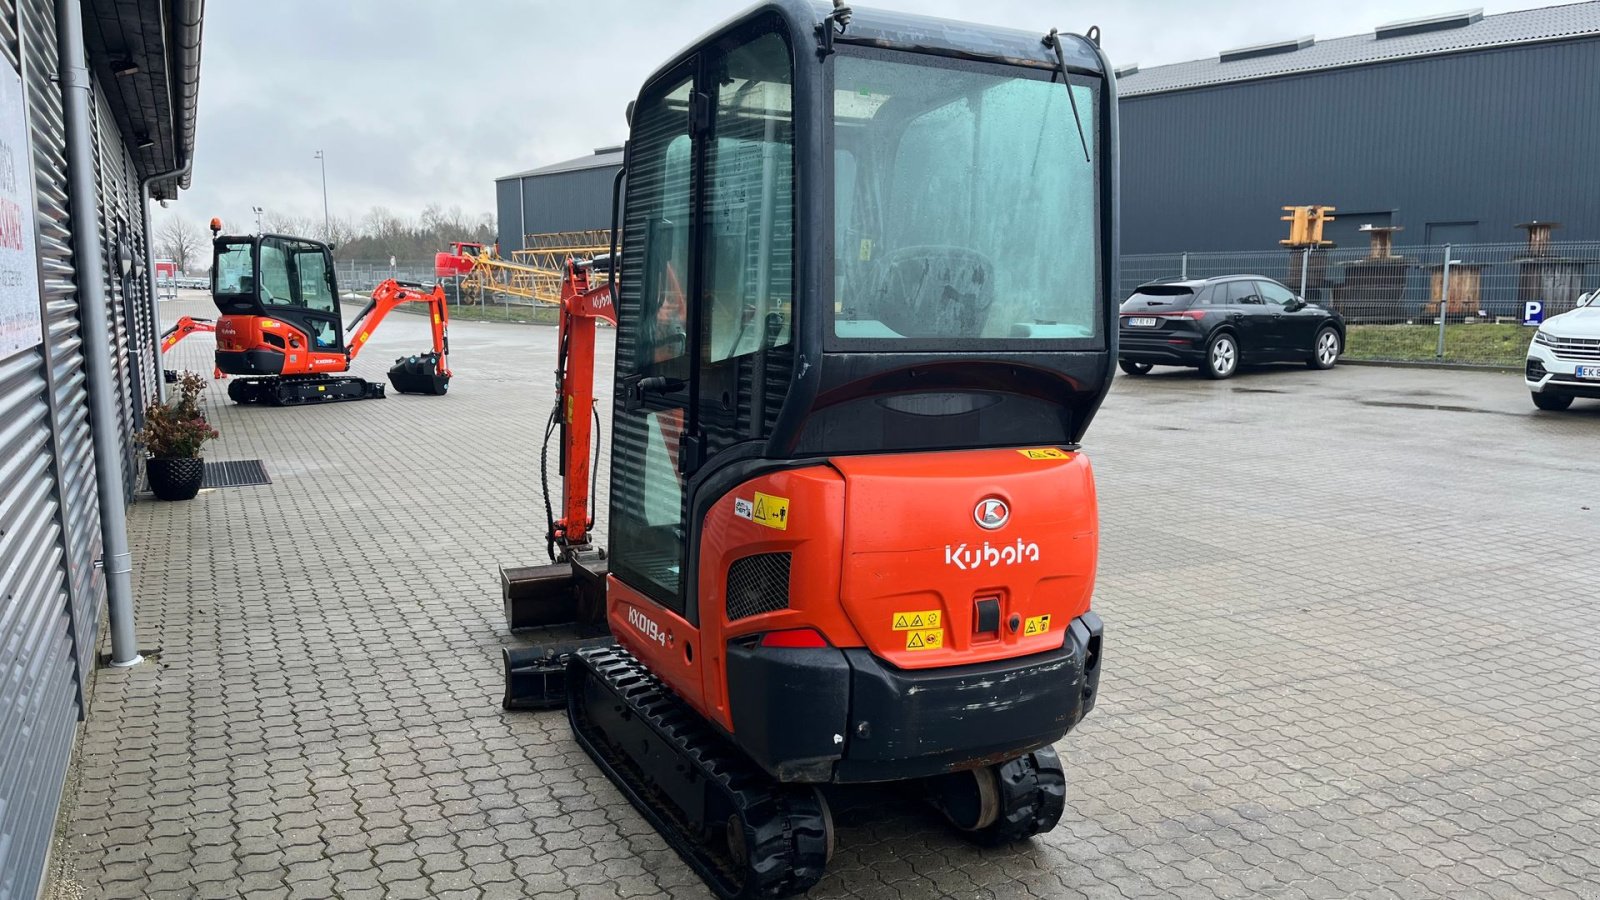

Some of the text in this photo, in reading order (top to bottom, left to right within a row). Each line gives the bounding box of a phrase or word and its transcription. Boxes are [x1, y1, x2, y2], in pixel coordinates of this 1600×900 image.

[1525, 301, 1541, 320] P
[1583, 368, 1594, 376] EK
[945, 538, 1039, 569] Kubota
[628, 605, 666, 647] KX019-4
